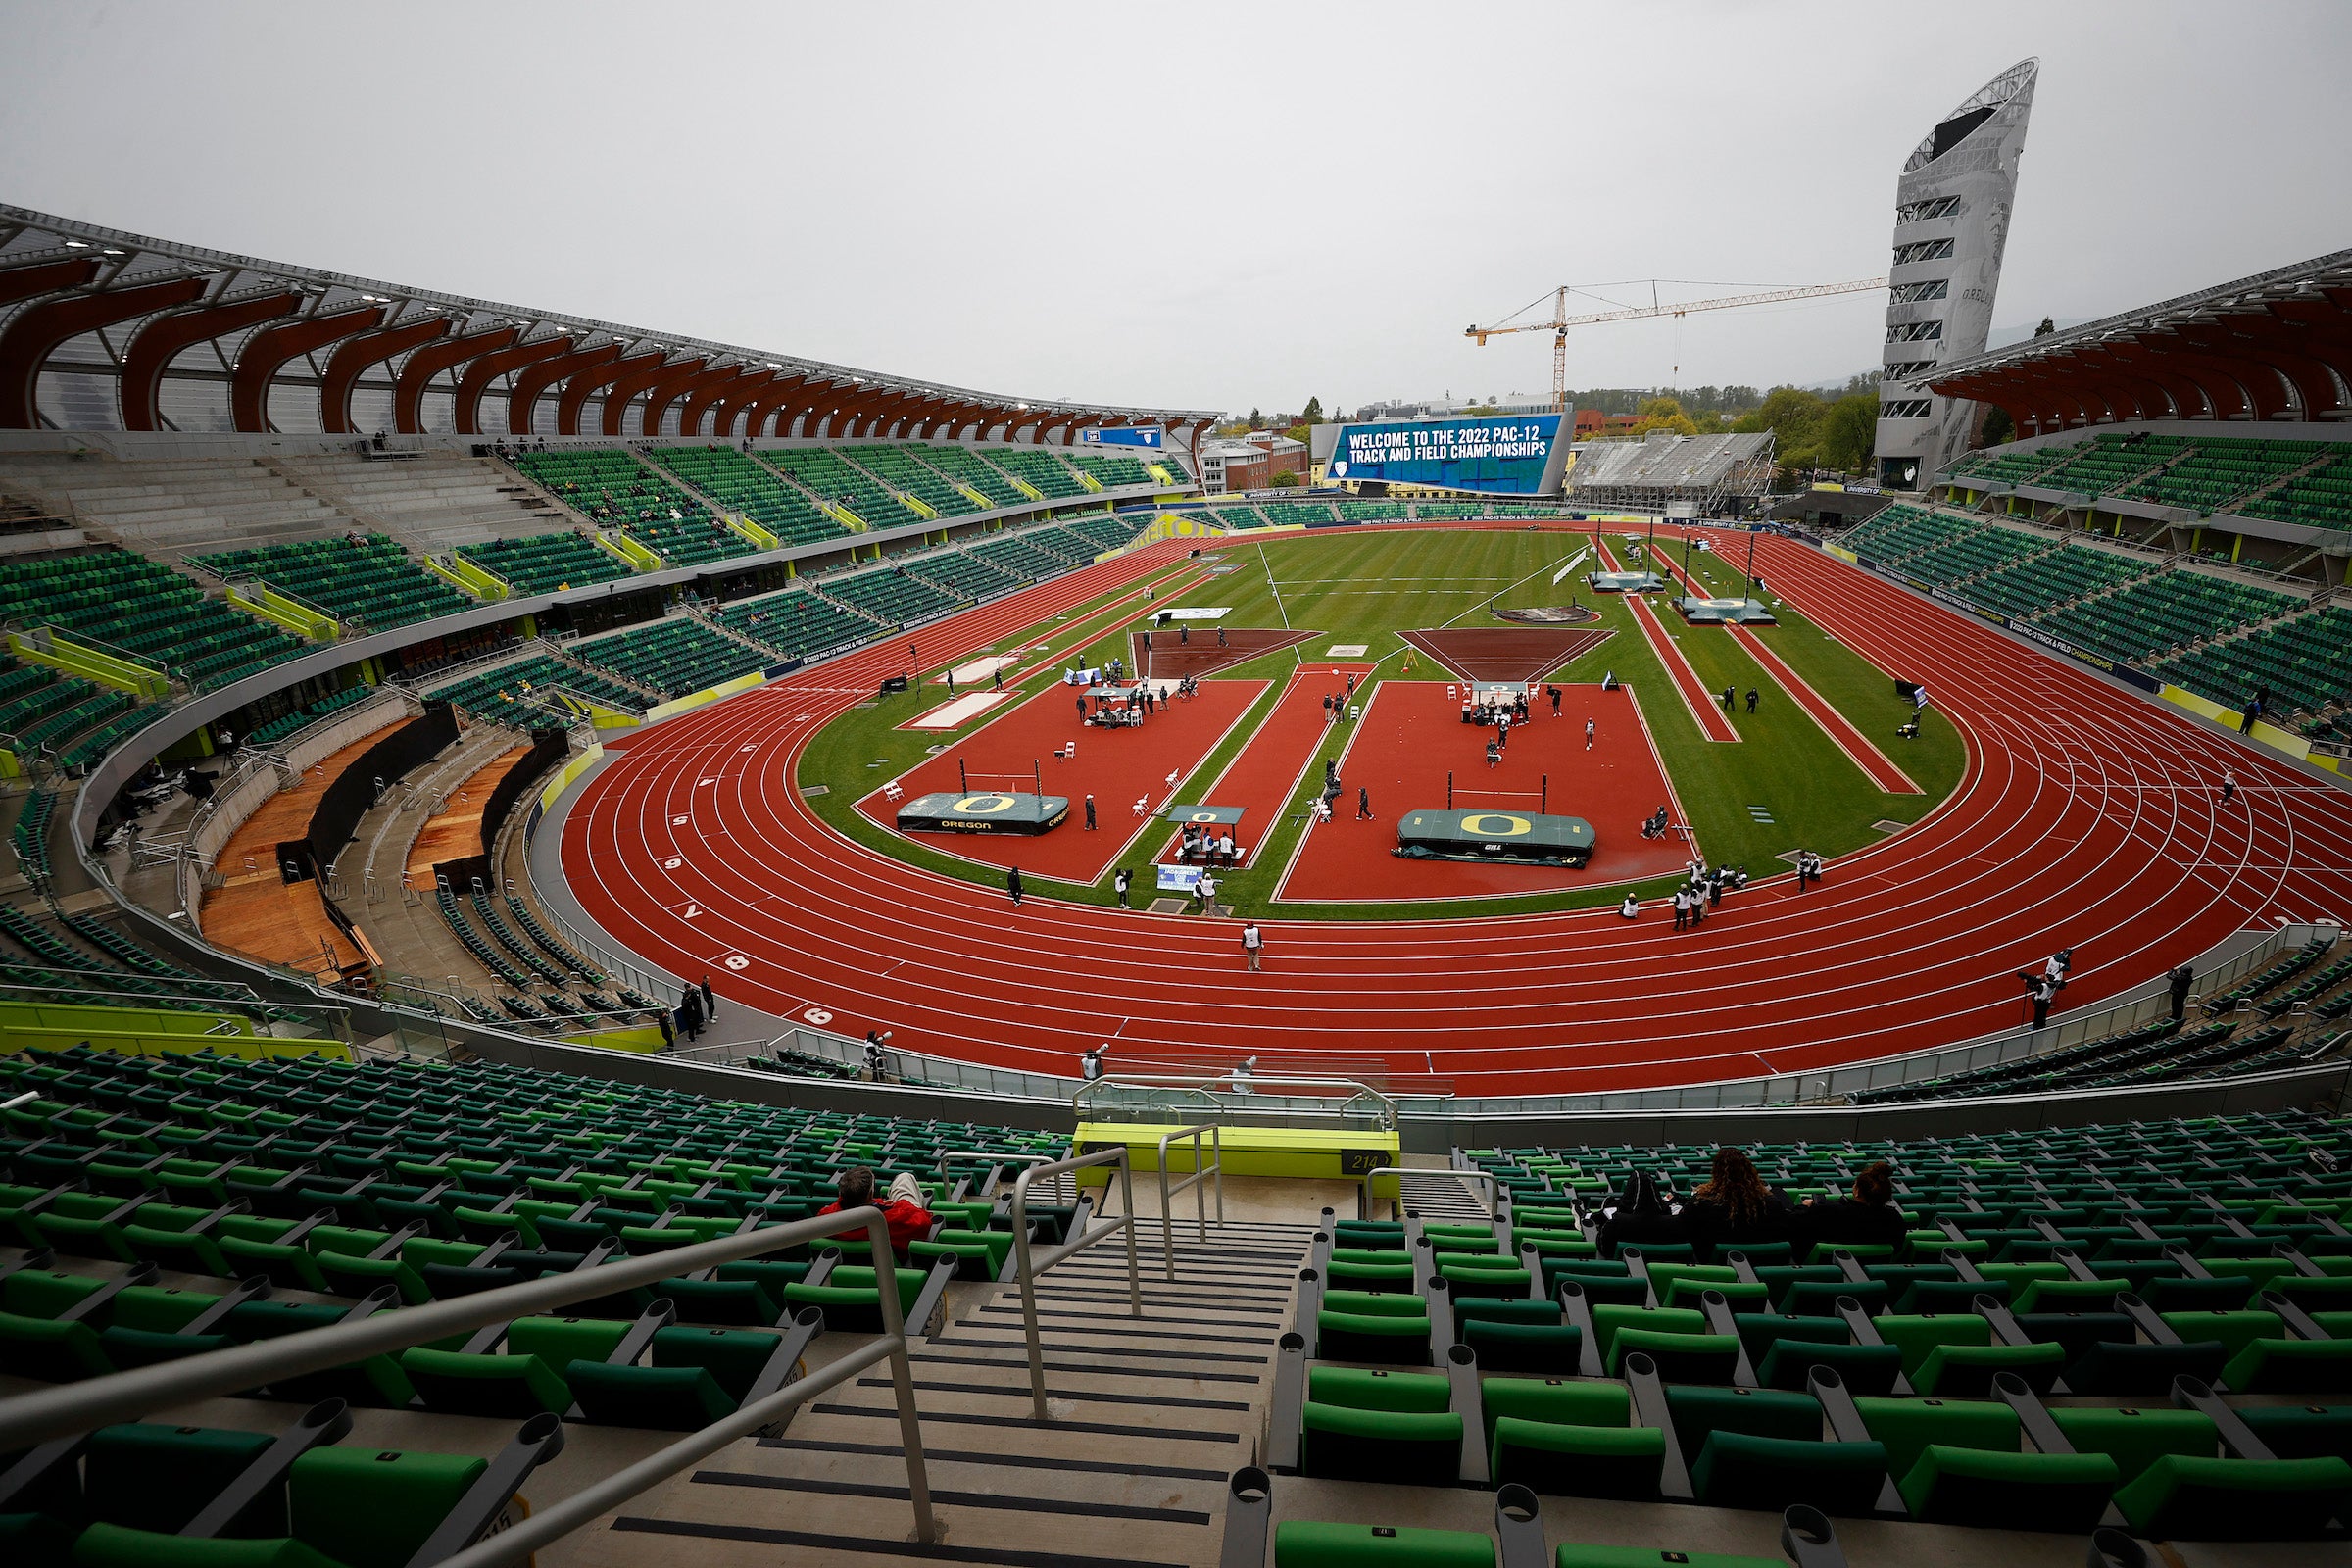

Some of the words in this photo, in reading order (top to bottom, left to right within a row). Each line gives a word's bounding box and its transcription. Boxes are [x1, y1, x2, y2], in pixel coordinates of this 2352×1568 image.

[1349, 432, 1409, 450] WELCOME
[1412, 431, 1428, 446] TO
[1432, 429, 1454, 445] THE
[1458, 427, 1489, 444] 2022
[1493, 425, 1540, 442] PAC-12
[1349, 448, 1387, 464] TRACK
[1389, 447, 1411, 462] AND
[1414, 445, 1446, 461] FIELD
[1450, 441, 1546, 459] CHAMPIONSHIPS
[941, 820, 992, 830] OREGON
[724, 955, 750, 970] 8
[1352, 1154, 1379, 1169] 214
